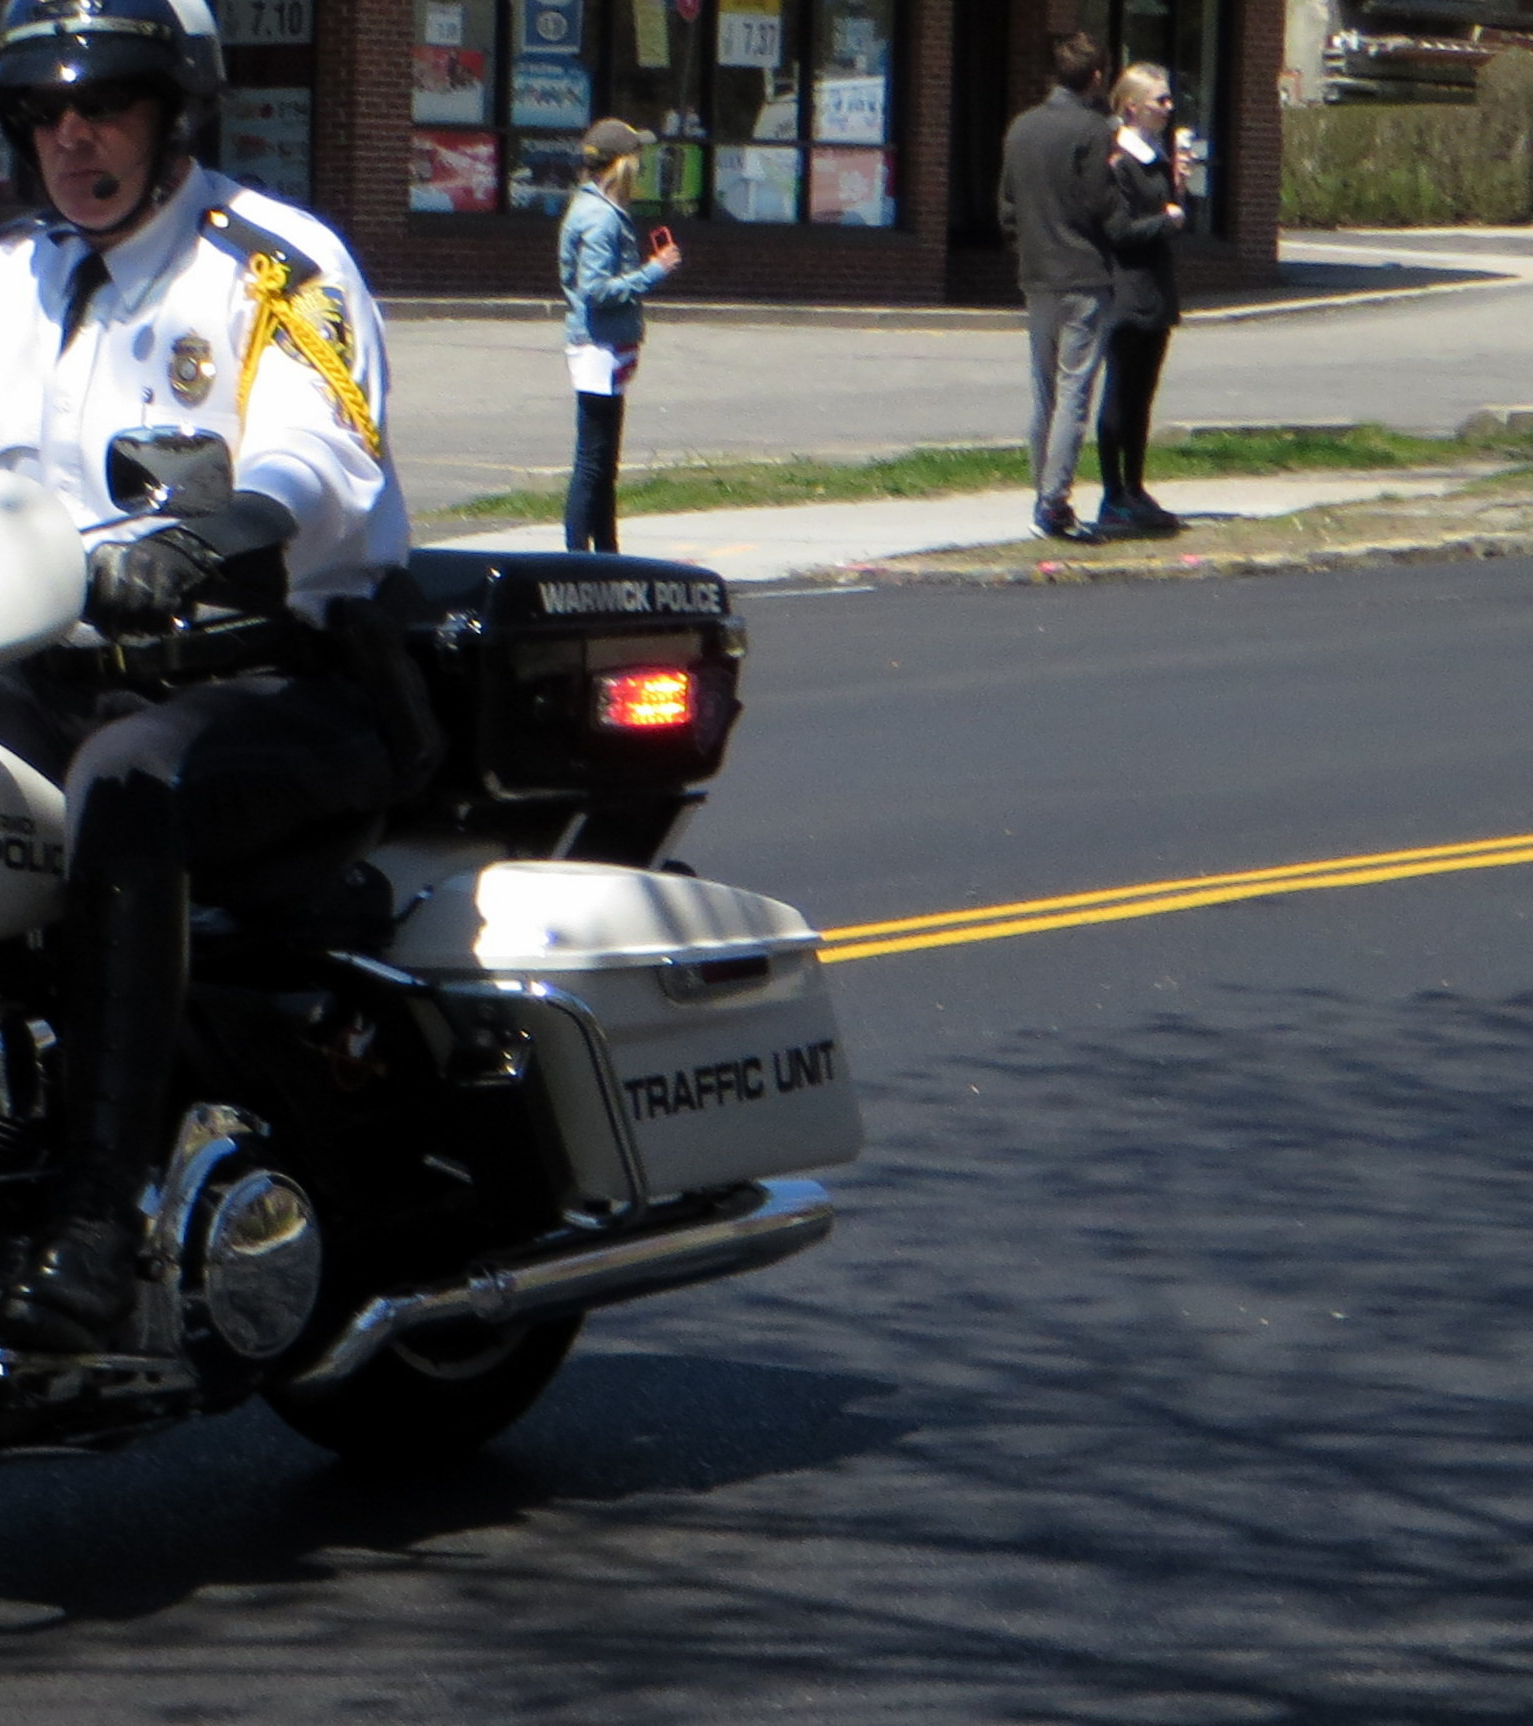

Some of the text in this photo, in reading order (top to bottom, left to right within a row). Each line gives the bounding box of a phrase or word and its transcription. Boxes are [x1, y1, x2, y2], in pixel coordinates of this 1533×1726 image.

[538, 580, 724, 615] WARWICK POLICE
[623, 1039, 835, 1121] TRAFFIC UNIT
